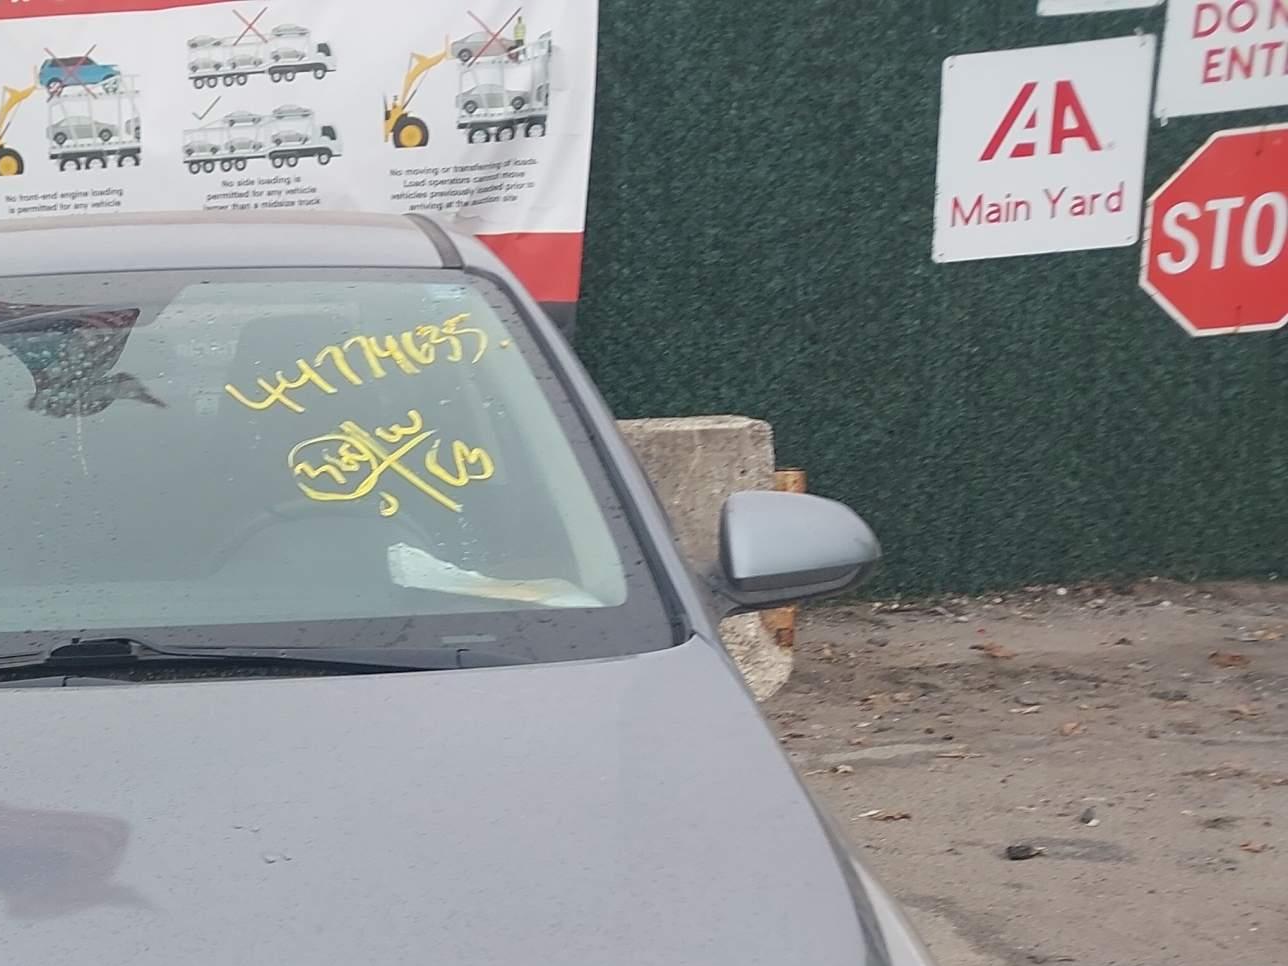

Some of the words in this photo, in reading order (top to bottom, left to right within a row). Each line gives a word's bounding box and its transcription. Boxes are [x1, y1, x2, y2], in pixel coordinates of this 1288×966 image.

[1192, 0, 1258, 38] DO
[1201, 41, 1288, 84] ENT
[258, 175, 291, 185] loading
[403, 179, 425, 188] Load
[92, 187, 123, 197] loading
[206, 190, 250, 201] permitted
[951, 193, 1031, 228] Main
[1043, 181, 1125, 219] Yard
